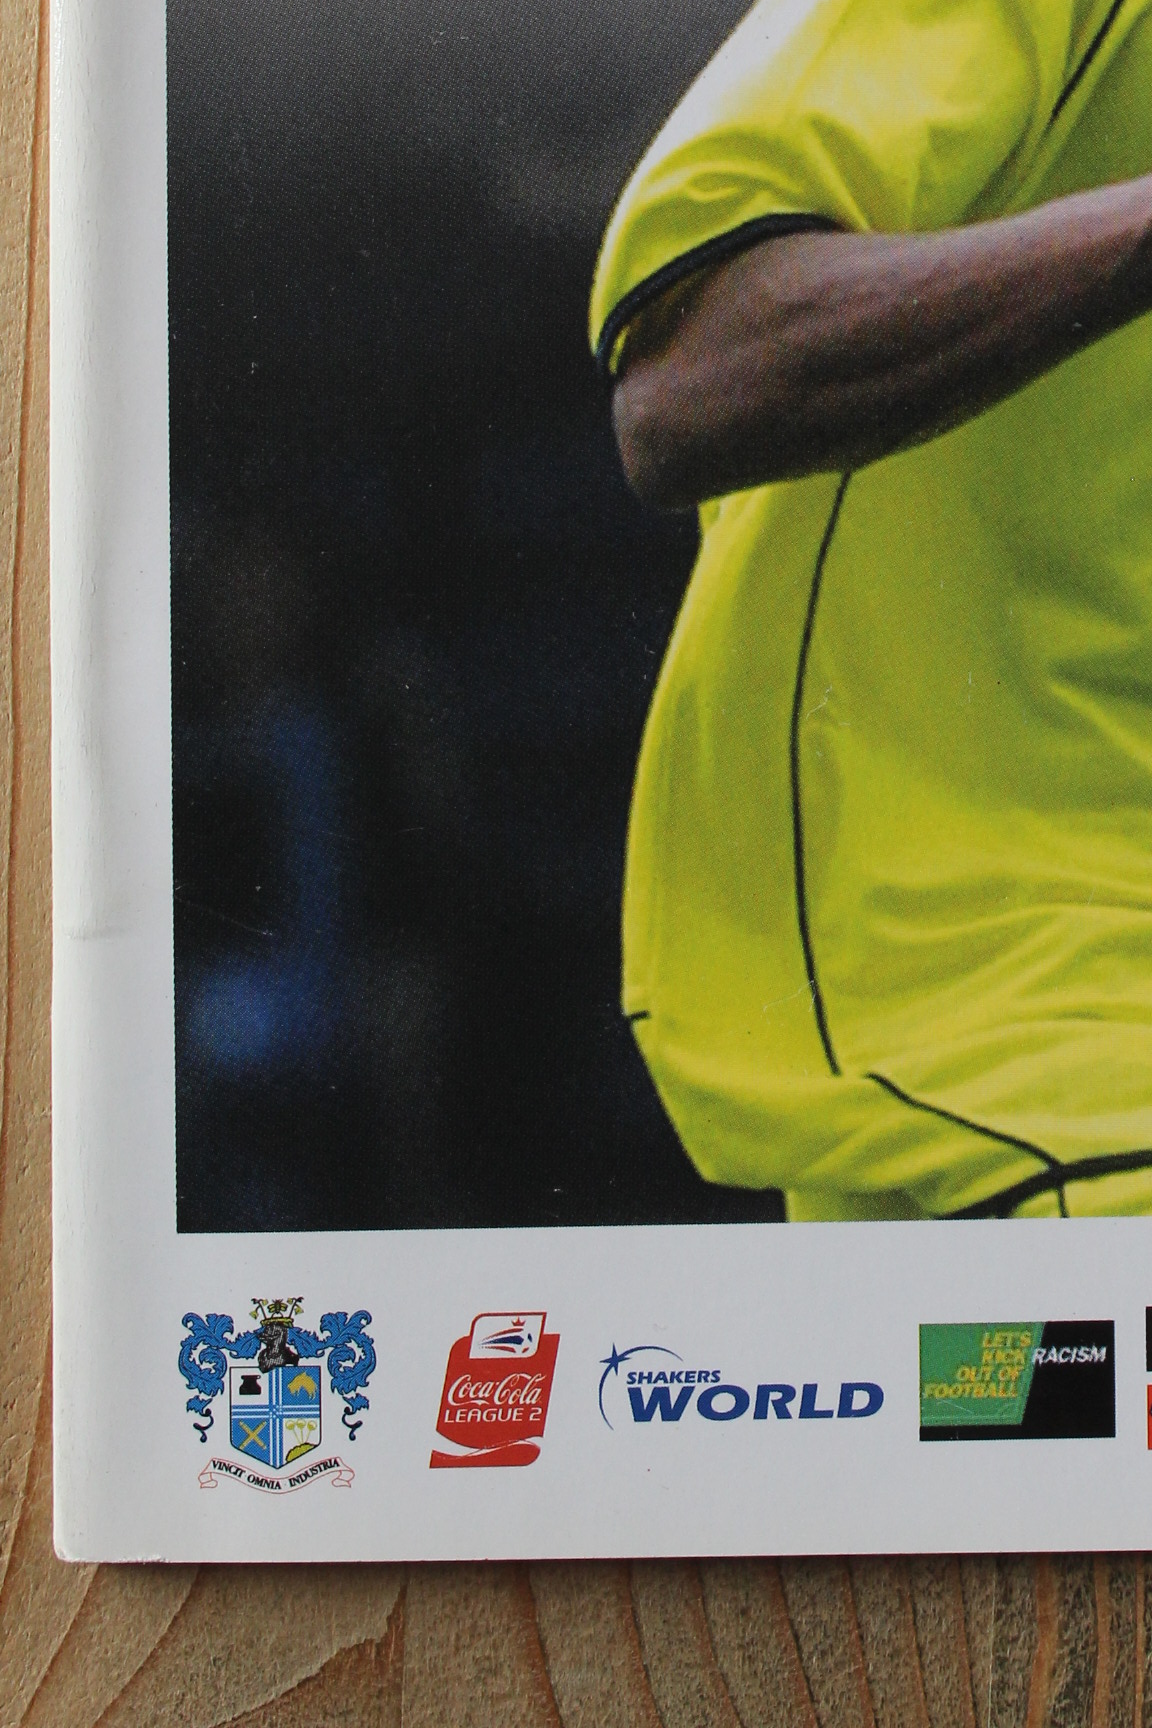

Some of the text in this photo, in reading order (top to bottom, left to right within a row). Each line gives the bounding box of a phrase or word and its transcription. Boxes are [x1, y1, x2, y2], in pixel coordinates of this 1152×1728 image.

[1033, 1346, 1107, 1364] RACISM
[626, 1370, 721, 1385] SHAKERS
[923, 1383, 1018, 1398] FOOTBALL
[627, 1382, 884, 1422] WORLD
[444, 1407, 544, 1424] LEAGUE 2
[212, 1458, 340, 1490] VINCIT OMNIA INDUSTRIA
